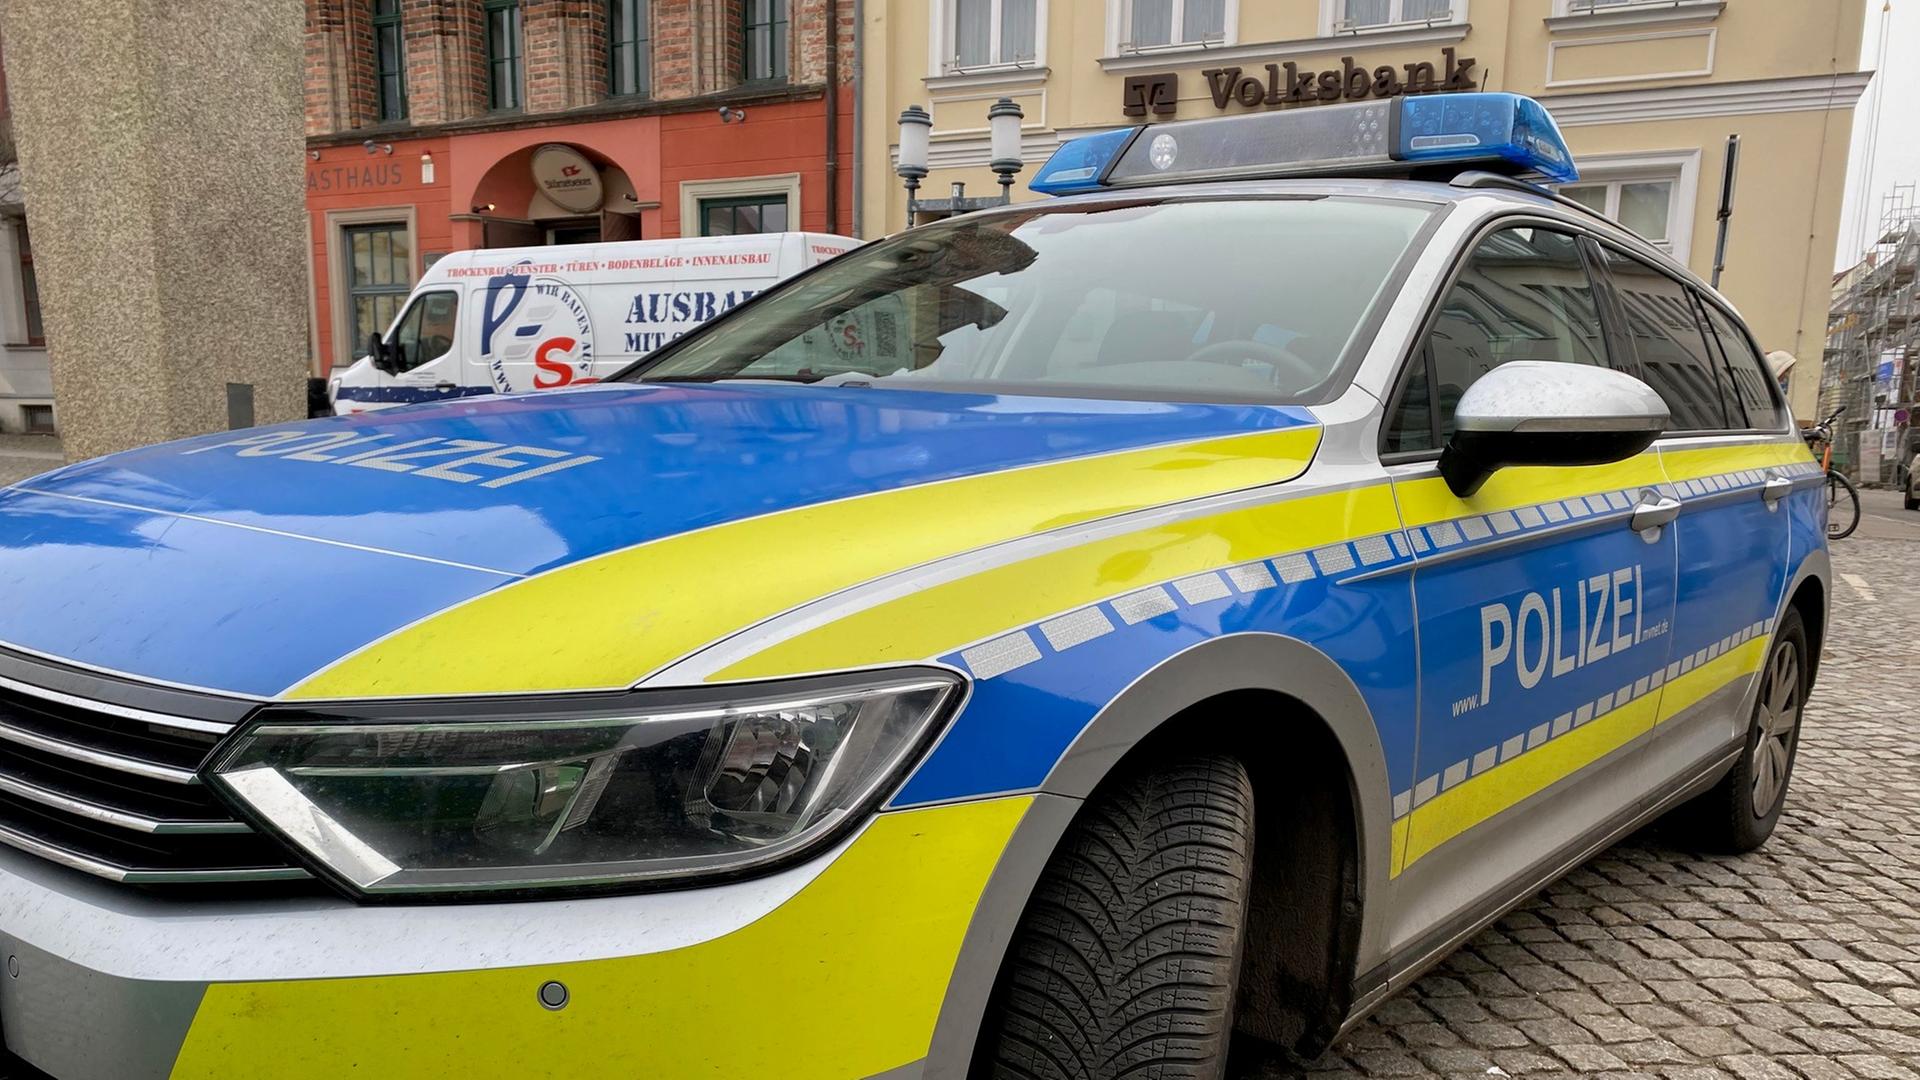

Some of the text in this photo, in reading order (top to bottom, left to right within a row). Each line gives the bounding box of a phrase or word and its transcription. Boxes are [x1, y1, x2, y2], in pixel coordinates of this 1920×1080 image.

[1202, 47, 1477, 109] Volksbank
[307, 163, 402, 191] ASTHAUS
[566, 260, 599, 272] TÜREN
[607, 256, 683, 270] BODENBELÄGE
[692, 253, 771, 267] INNENAUSBAU
[561, 290, 590, 335] BAUEN
[625, 290, 766, 323] AUSBA
[625, 332, 665, 352] MIT
[180, 431, 604, 489] POLIZEI
